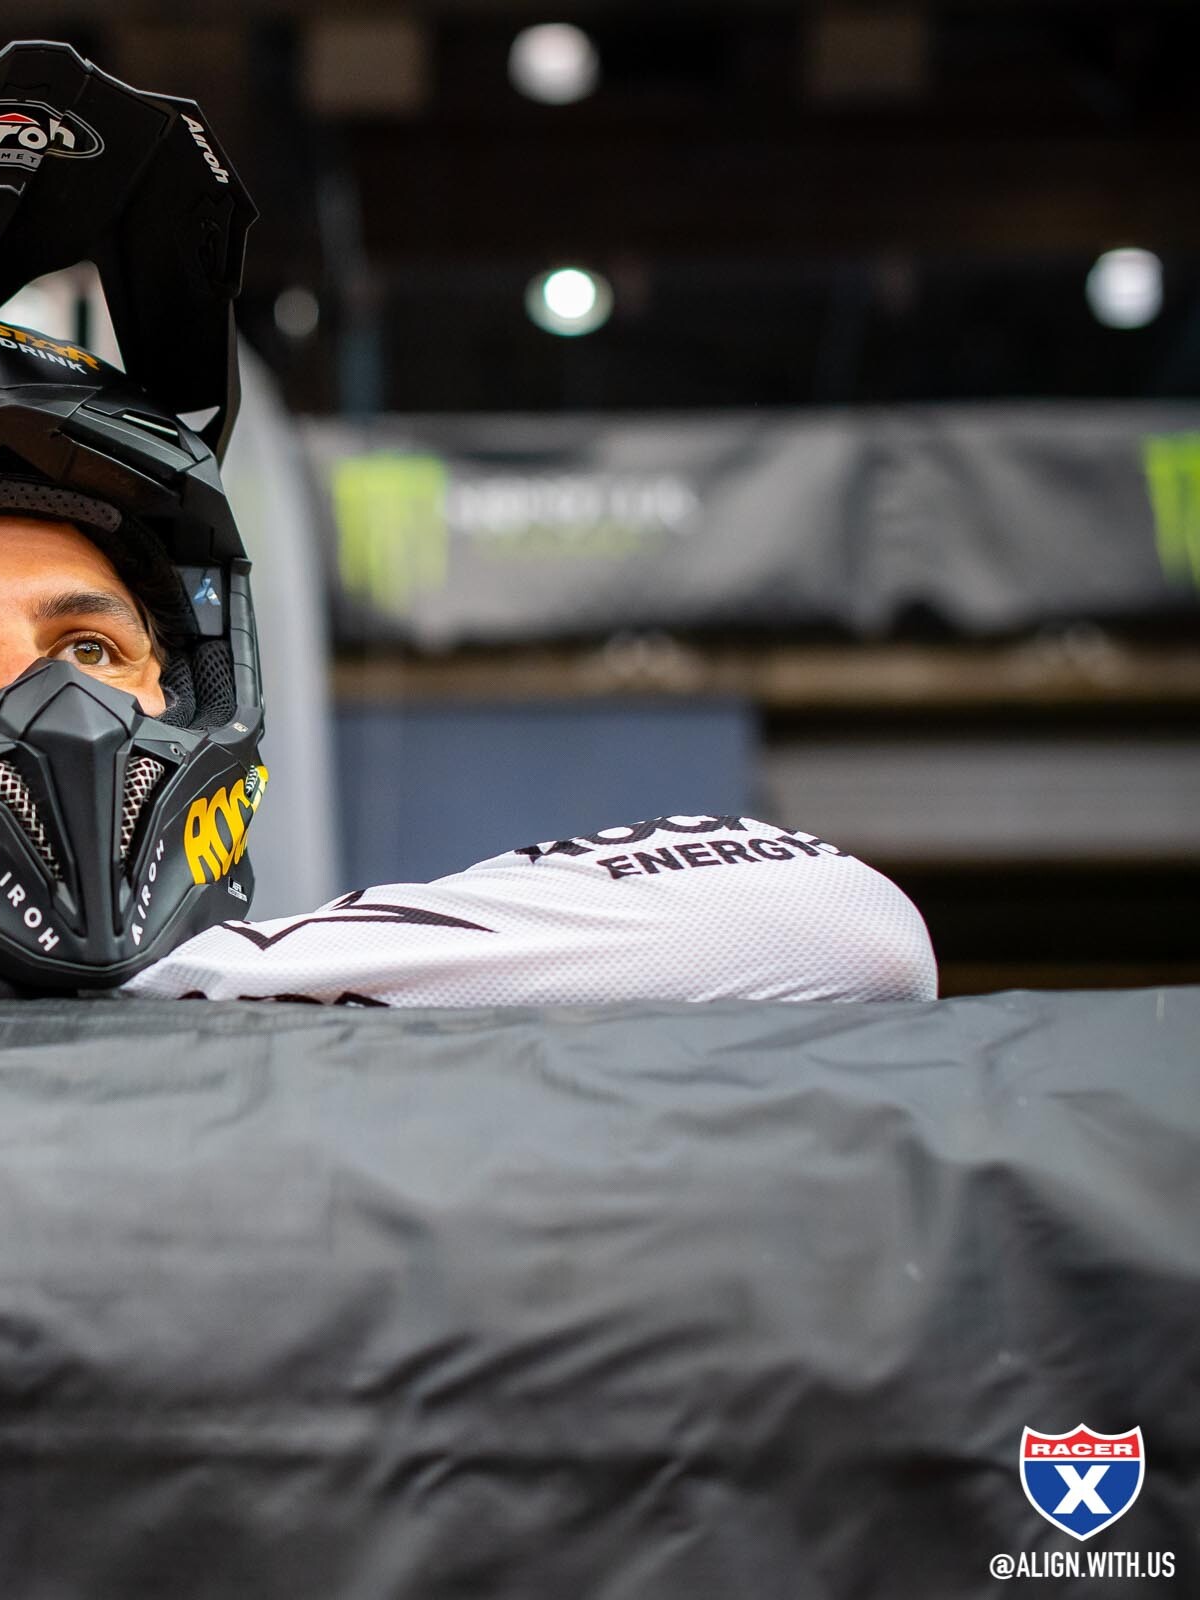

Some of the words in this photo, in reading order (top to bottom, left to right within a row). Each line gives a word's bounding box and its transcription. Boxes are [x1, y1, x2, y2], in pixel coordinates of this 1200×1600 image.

[180, 113, 229, 184] Airoh
[131, 839, 165, 946] AIROH
[597, 834, 821, 880] ENERGY
